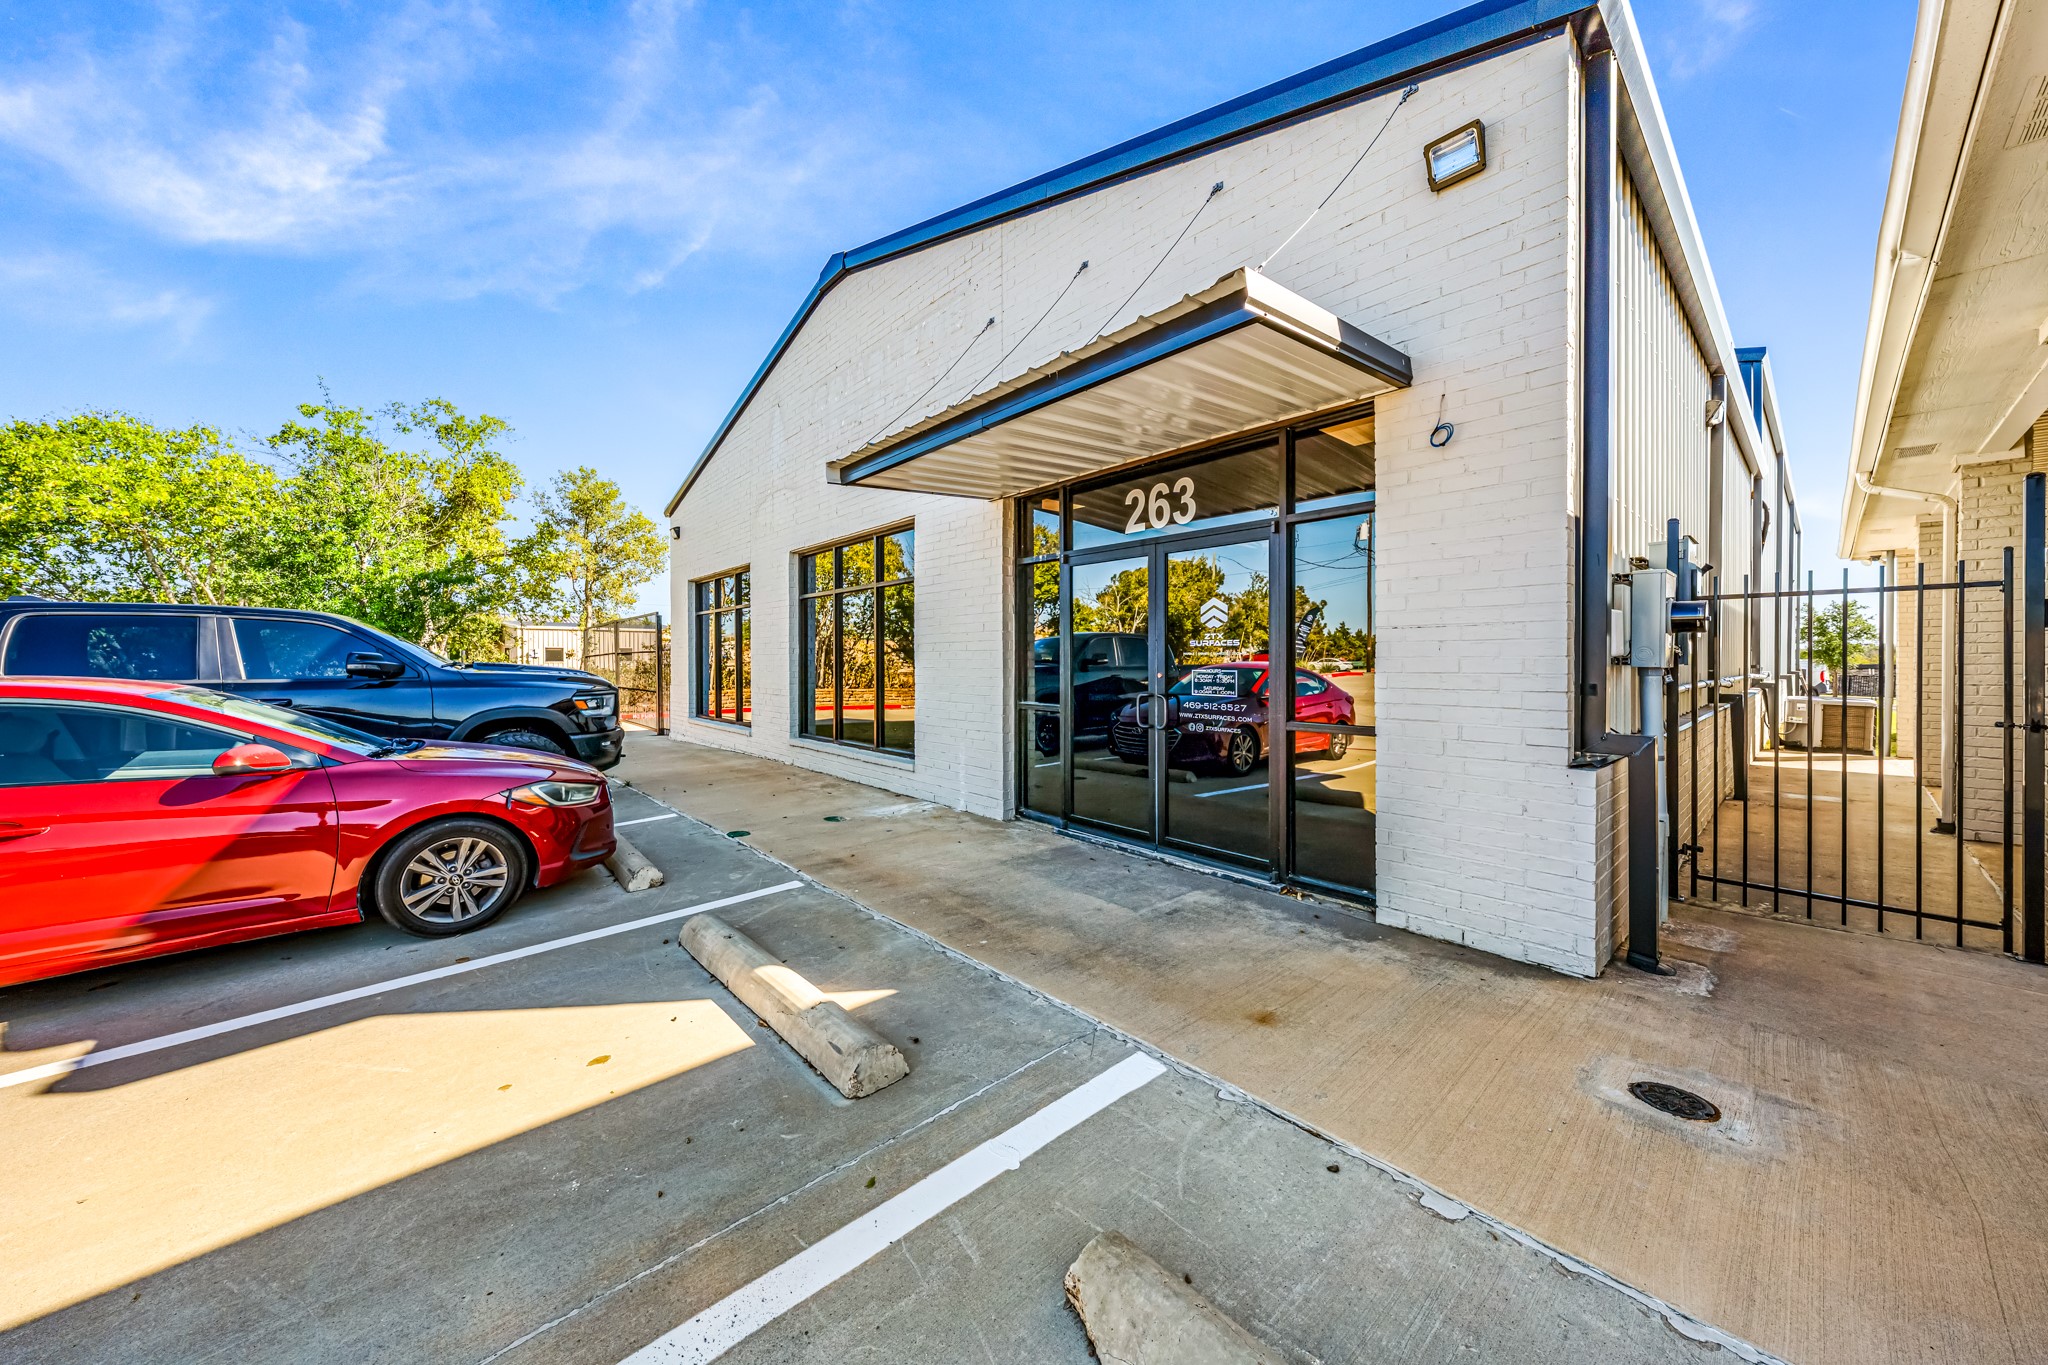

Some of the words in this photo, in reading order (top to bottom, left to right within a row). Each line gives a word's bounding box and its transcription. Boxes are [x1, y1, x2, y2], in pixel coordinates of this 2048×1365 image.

[1125, 477, 1197, 535] 263
[1189, 639, 1240, 647] SURFACES
[1183, 702, 1248, 712] 469-512-8527
[1179, 712, 1253, 723] WWW.ZTXSURFACES.COM
[1205, 726, 1242, 734] ZTXSURFACES
